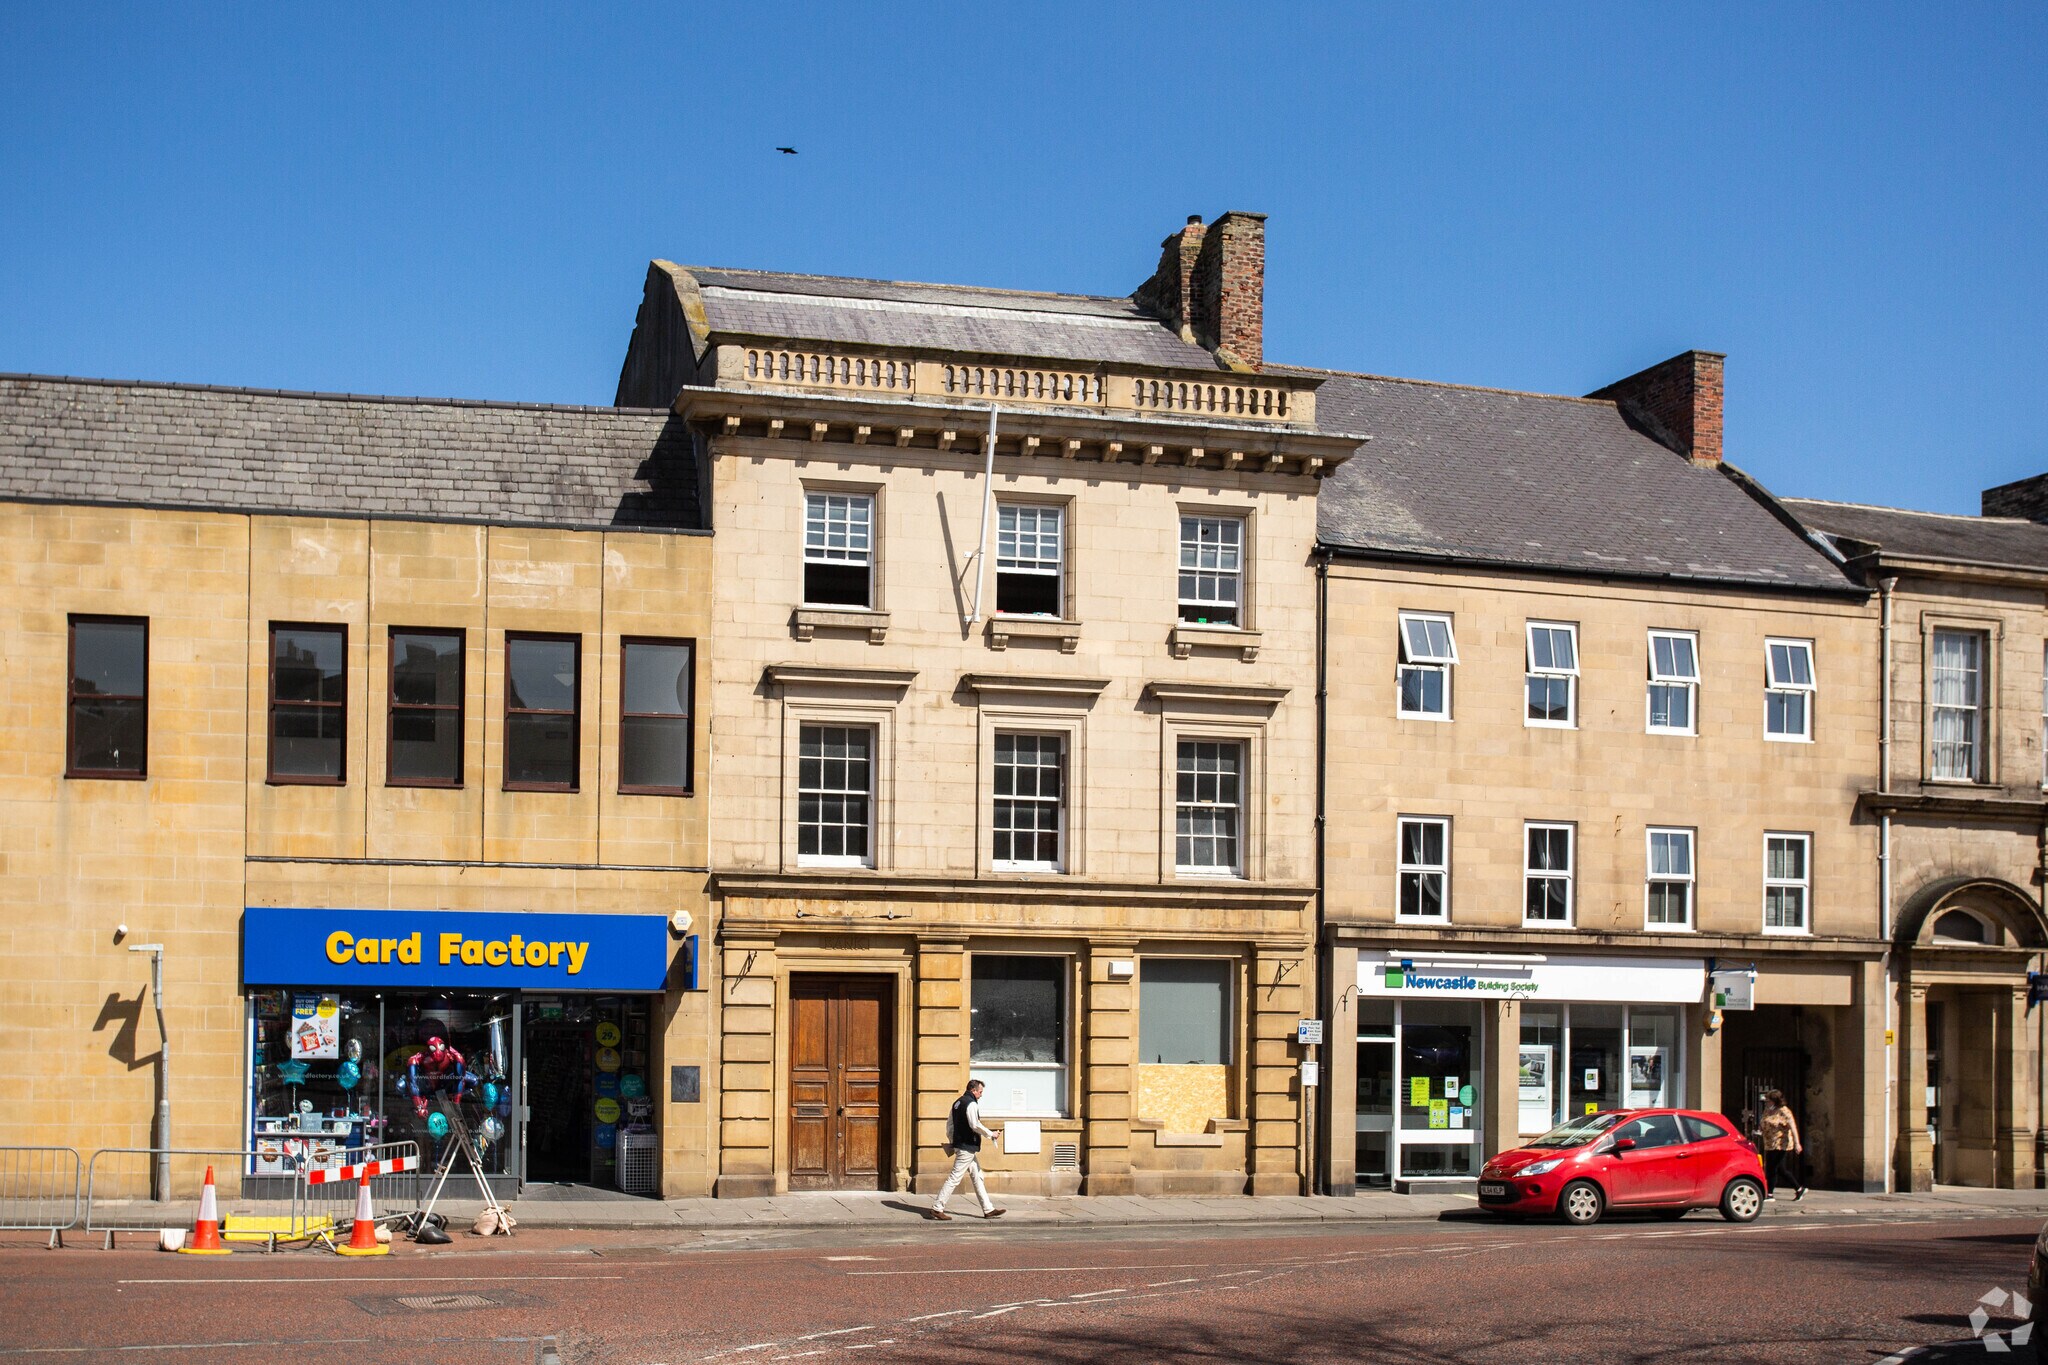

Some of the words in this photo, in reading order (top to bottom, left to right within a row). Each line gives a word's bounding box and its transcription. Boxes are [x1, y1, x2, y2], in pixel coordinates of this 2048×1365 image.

[325, 930, 422, 965] Card
[438, 932, 590, 975] Factory
[1405, 974, 1477, 990] Newcastle
[1477, 980, 1509, 992] Building
[1511, 981, 1539, 993] Society
